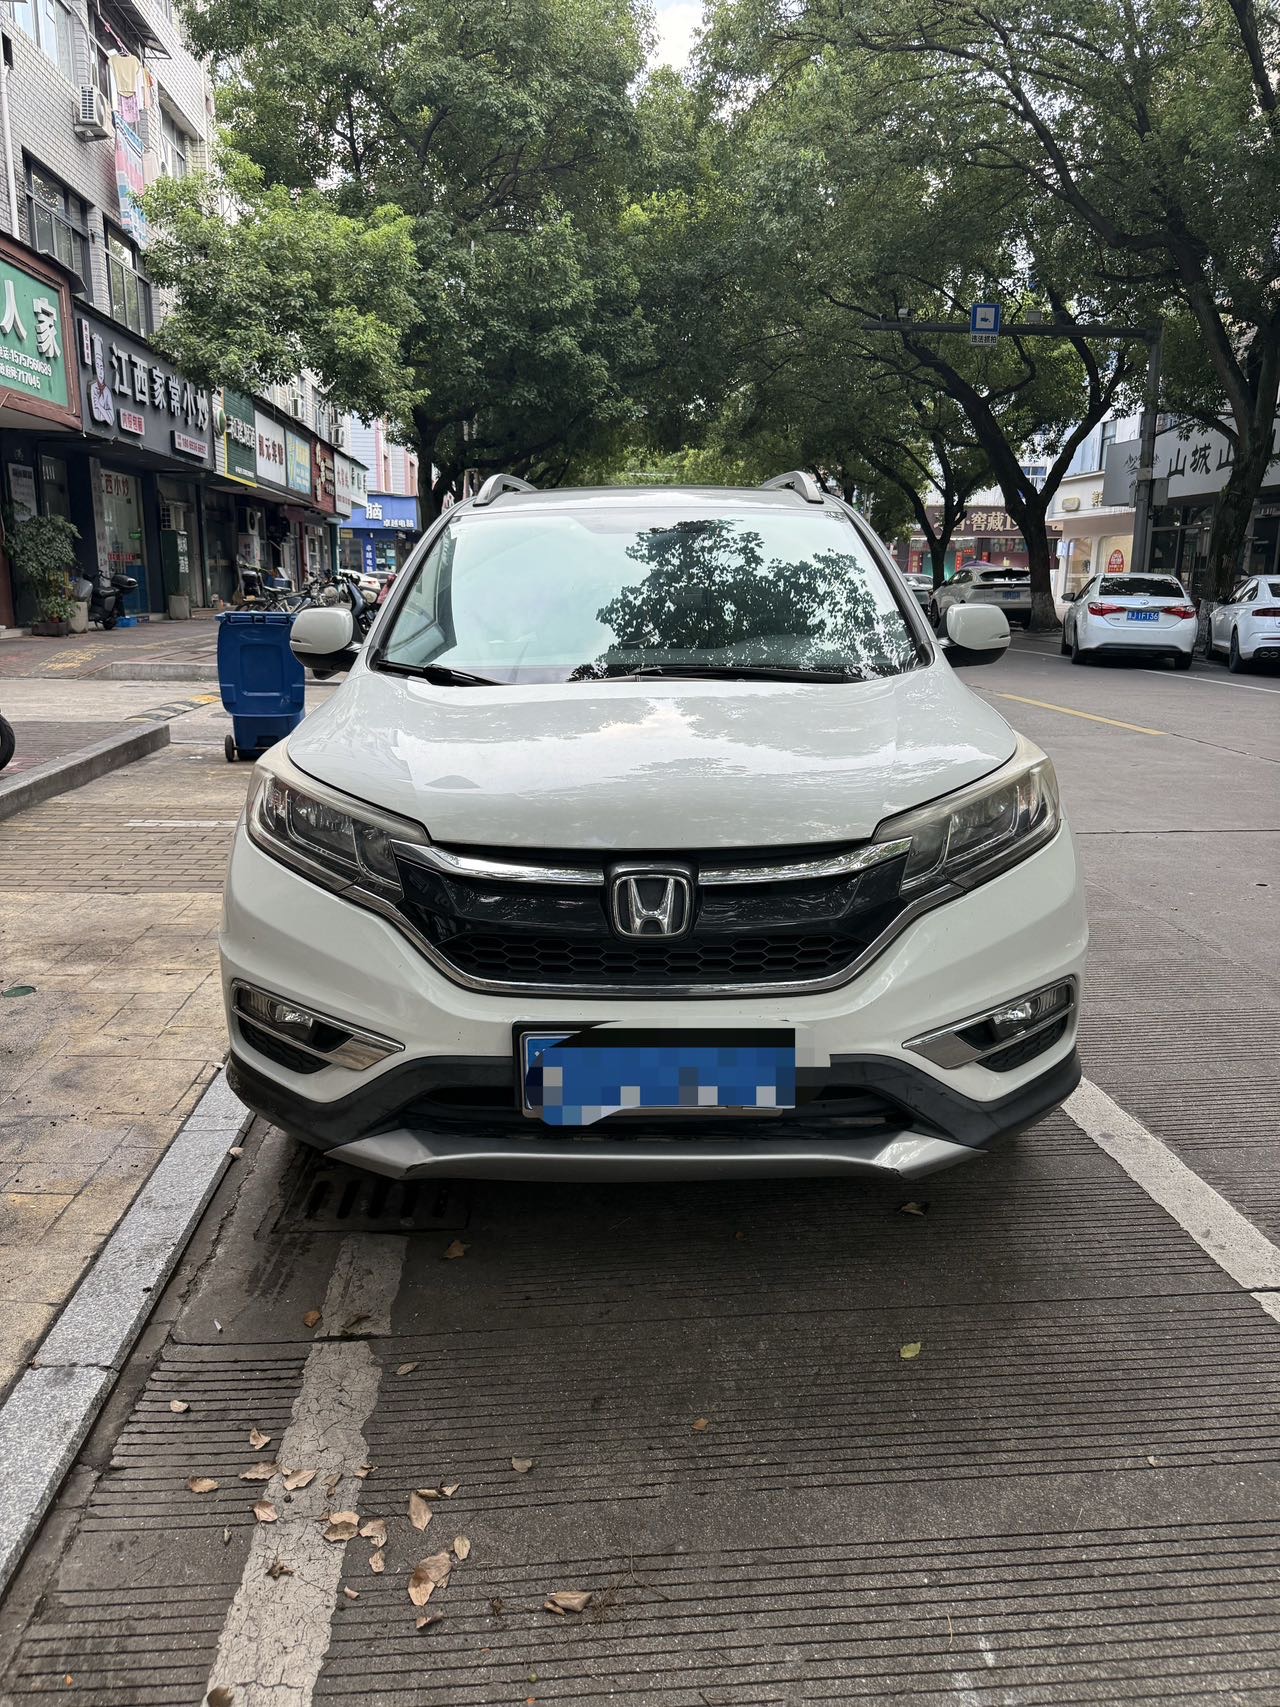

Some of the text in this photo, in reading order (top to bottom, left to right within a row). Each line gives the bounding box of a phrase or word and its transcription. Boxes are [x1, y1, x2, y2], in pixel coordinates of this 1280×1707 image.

[0, 280, 61, 358] 人家
[971, 334, 997, 344] 违法抓拍
[110, 341, 209, 432] 江西家常小炒
[101, 473, 129, 497] 西小炒
[383, 519, 414, 528] 卓越电脑
